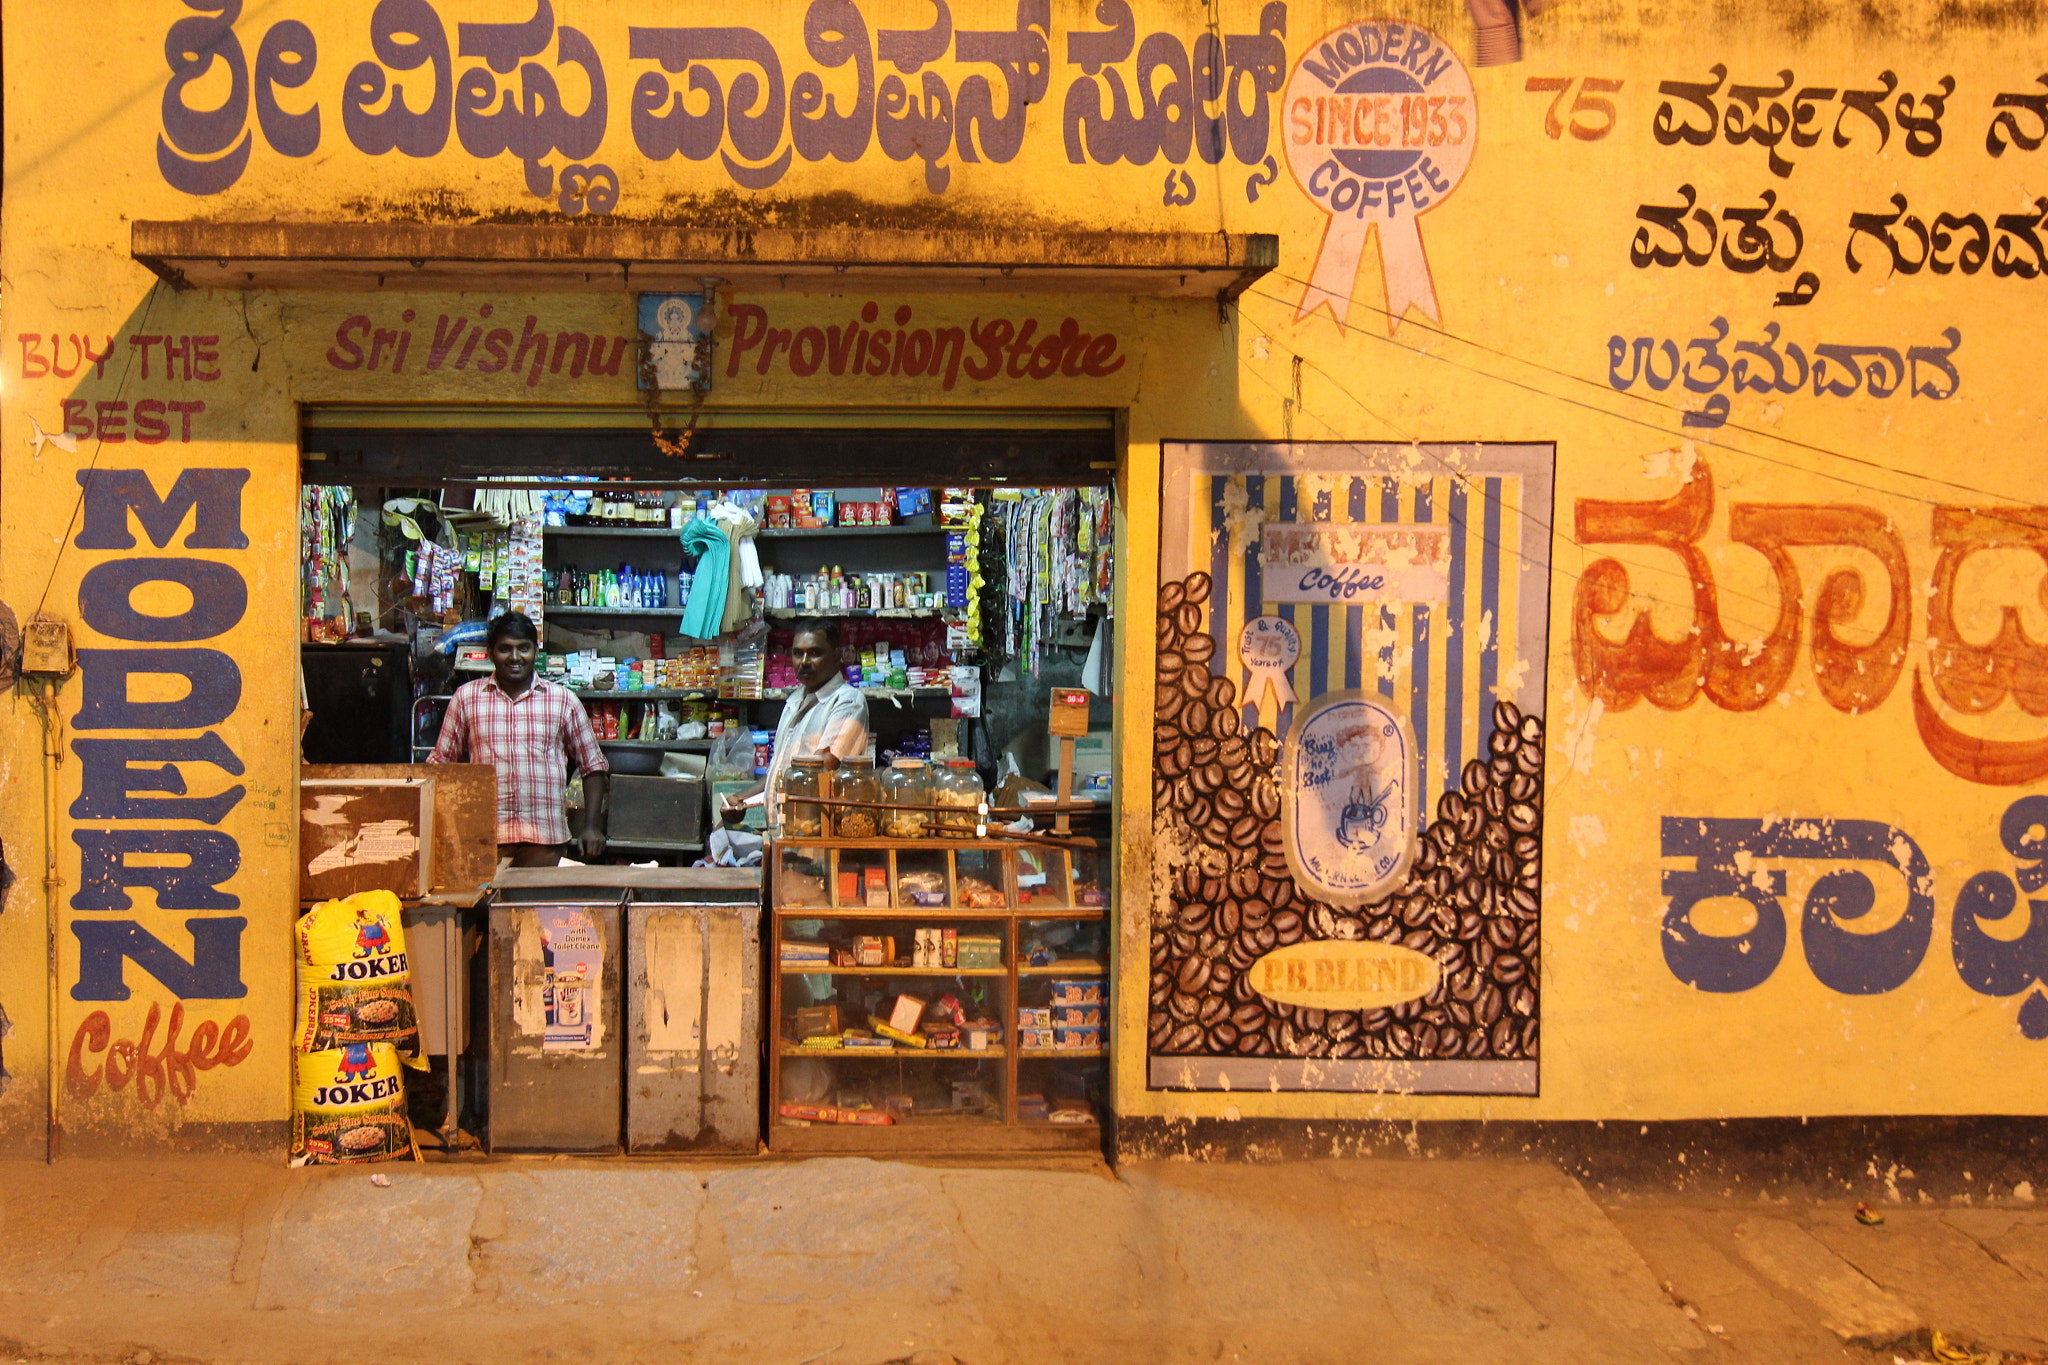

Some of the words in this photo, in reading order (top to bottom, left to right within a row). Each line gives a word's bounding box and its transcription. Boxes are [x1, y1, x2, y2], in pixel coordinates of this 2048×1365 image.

[1303, 25, 1452, 88] MODERN
[1400, 96, 1467, 147] 1933
[1524, 76, 1625, 142] 75
[1653, 62, 1956, 178] ವರ್ಷಗಳ
[1309, 157, 1450, 219] COFFEE
[1629, 183, 1820, 308] ಮತ್ತು
[18, 333, 114, 380] BUY
[130, 334, 221, 382] THE
[326, 309, 416, 373] Sri
[426, 303, 627, 387] Vishnu
[726, 301, 965, 391] Provision
[963, 317, 1126, 381] Store
[1606, 315, 1961, 428] ಉತ್ತಮವಾದ
[60, 398, 206, 444] BEST
[1299, 567, 1384, 598] Coffee
[1256, 636, 1282, 656] 75
[69, 467, 251, 1001] MODERN
[1305, 739, 1335, 759] Buy
[331, 953, 408, 981] JOKER
[66, 1001, 254, 1108] Coffee
[313, 1075, 399, 1105] JOKER
